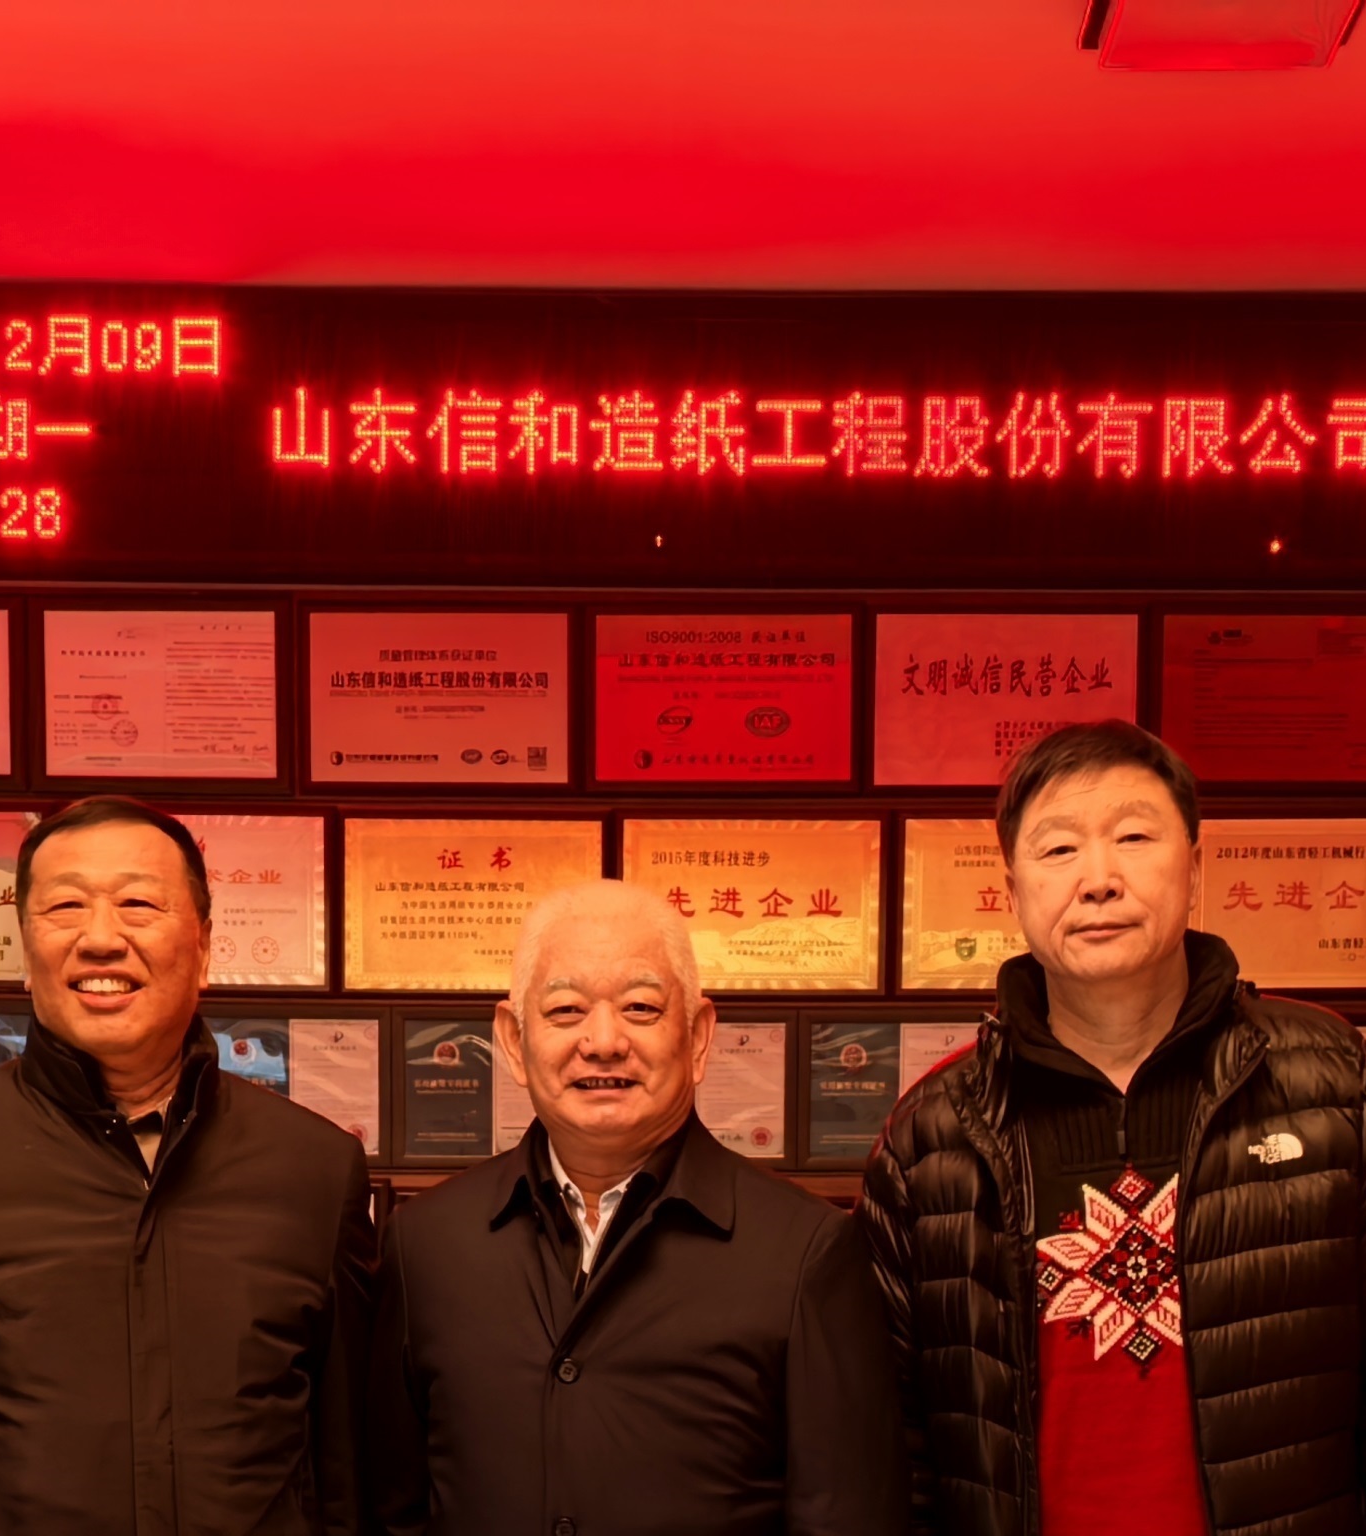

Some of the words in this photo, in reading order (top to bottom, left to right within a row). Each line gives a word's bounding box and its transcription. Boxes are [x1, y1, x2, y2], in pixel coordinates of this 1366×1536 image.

[330, 671, 549, 689] 山东信和造纸工程股份有限公司
[900, 653, 1113, 698] 文明诚信民营企业
[651, 849, 771, 868] 2015年度科技进步
[666, 886, 844, 919] 先进企业
